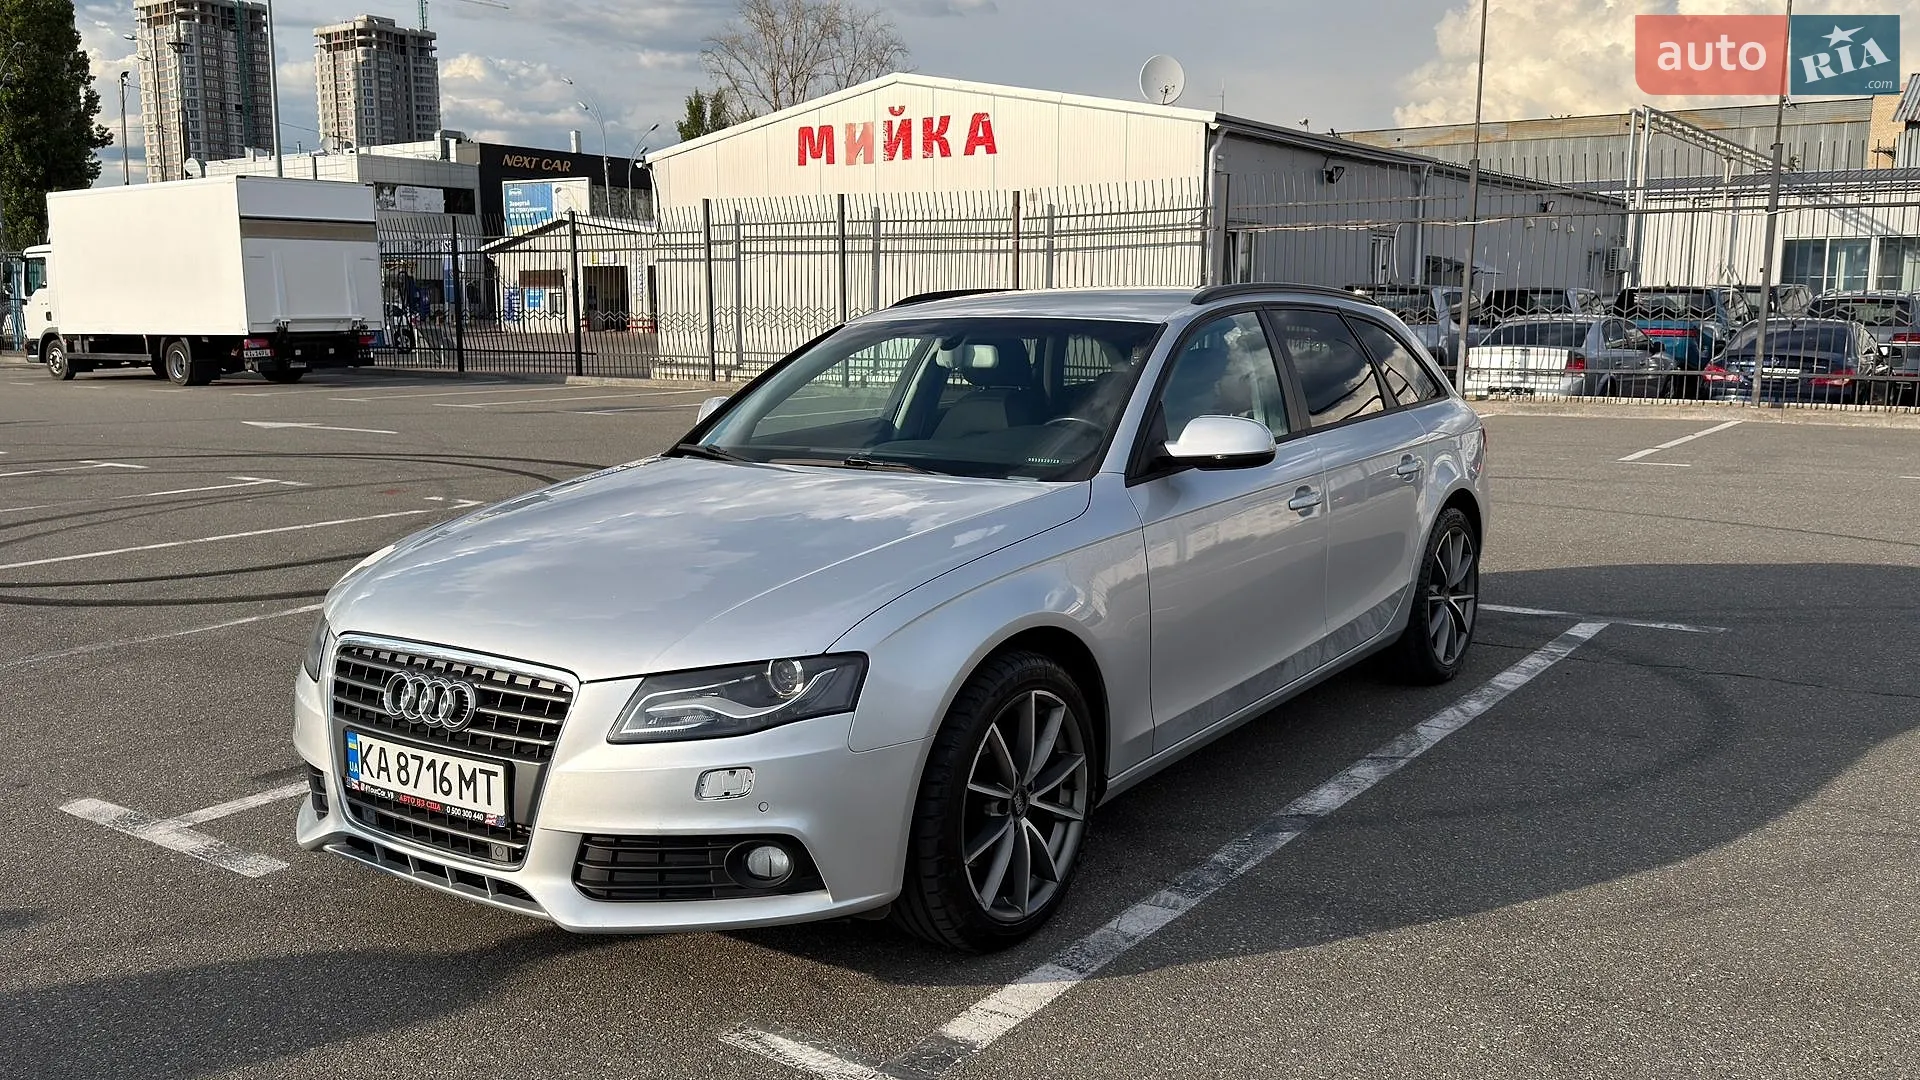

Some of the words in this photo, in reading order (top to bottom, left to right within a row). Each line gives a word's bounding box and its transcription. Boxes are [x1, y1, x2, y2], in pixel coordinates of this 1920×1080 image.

[797, 105, 998, 167] МИЙКА
[541, 158, 571, 172] CAR
[349, 761, 359, 773] UA
[358, 740, 392, 783] KA
[396, 751, 453, 797] 8716
[457, 763, 499, 806] MT
[400, 794, 415, 804] АВТО
[426, 801, 441, 811] США
[462, 809, 472, 819] 300
[473, 812, 484, 821] 440
